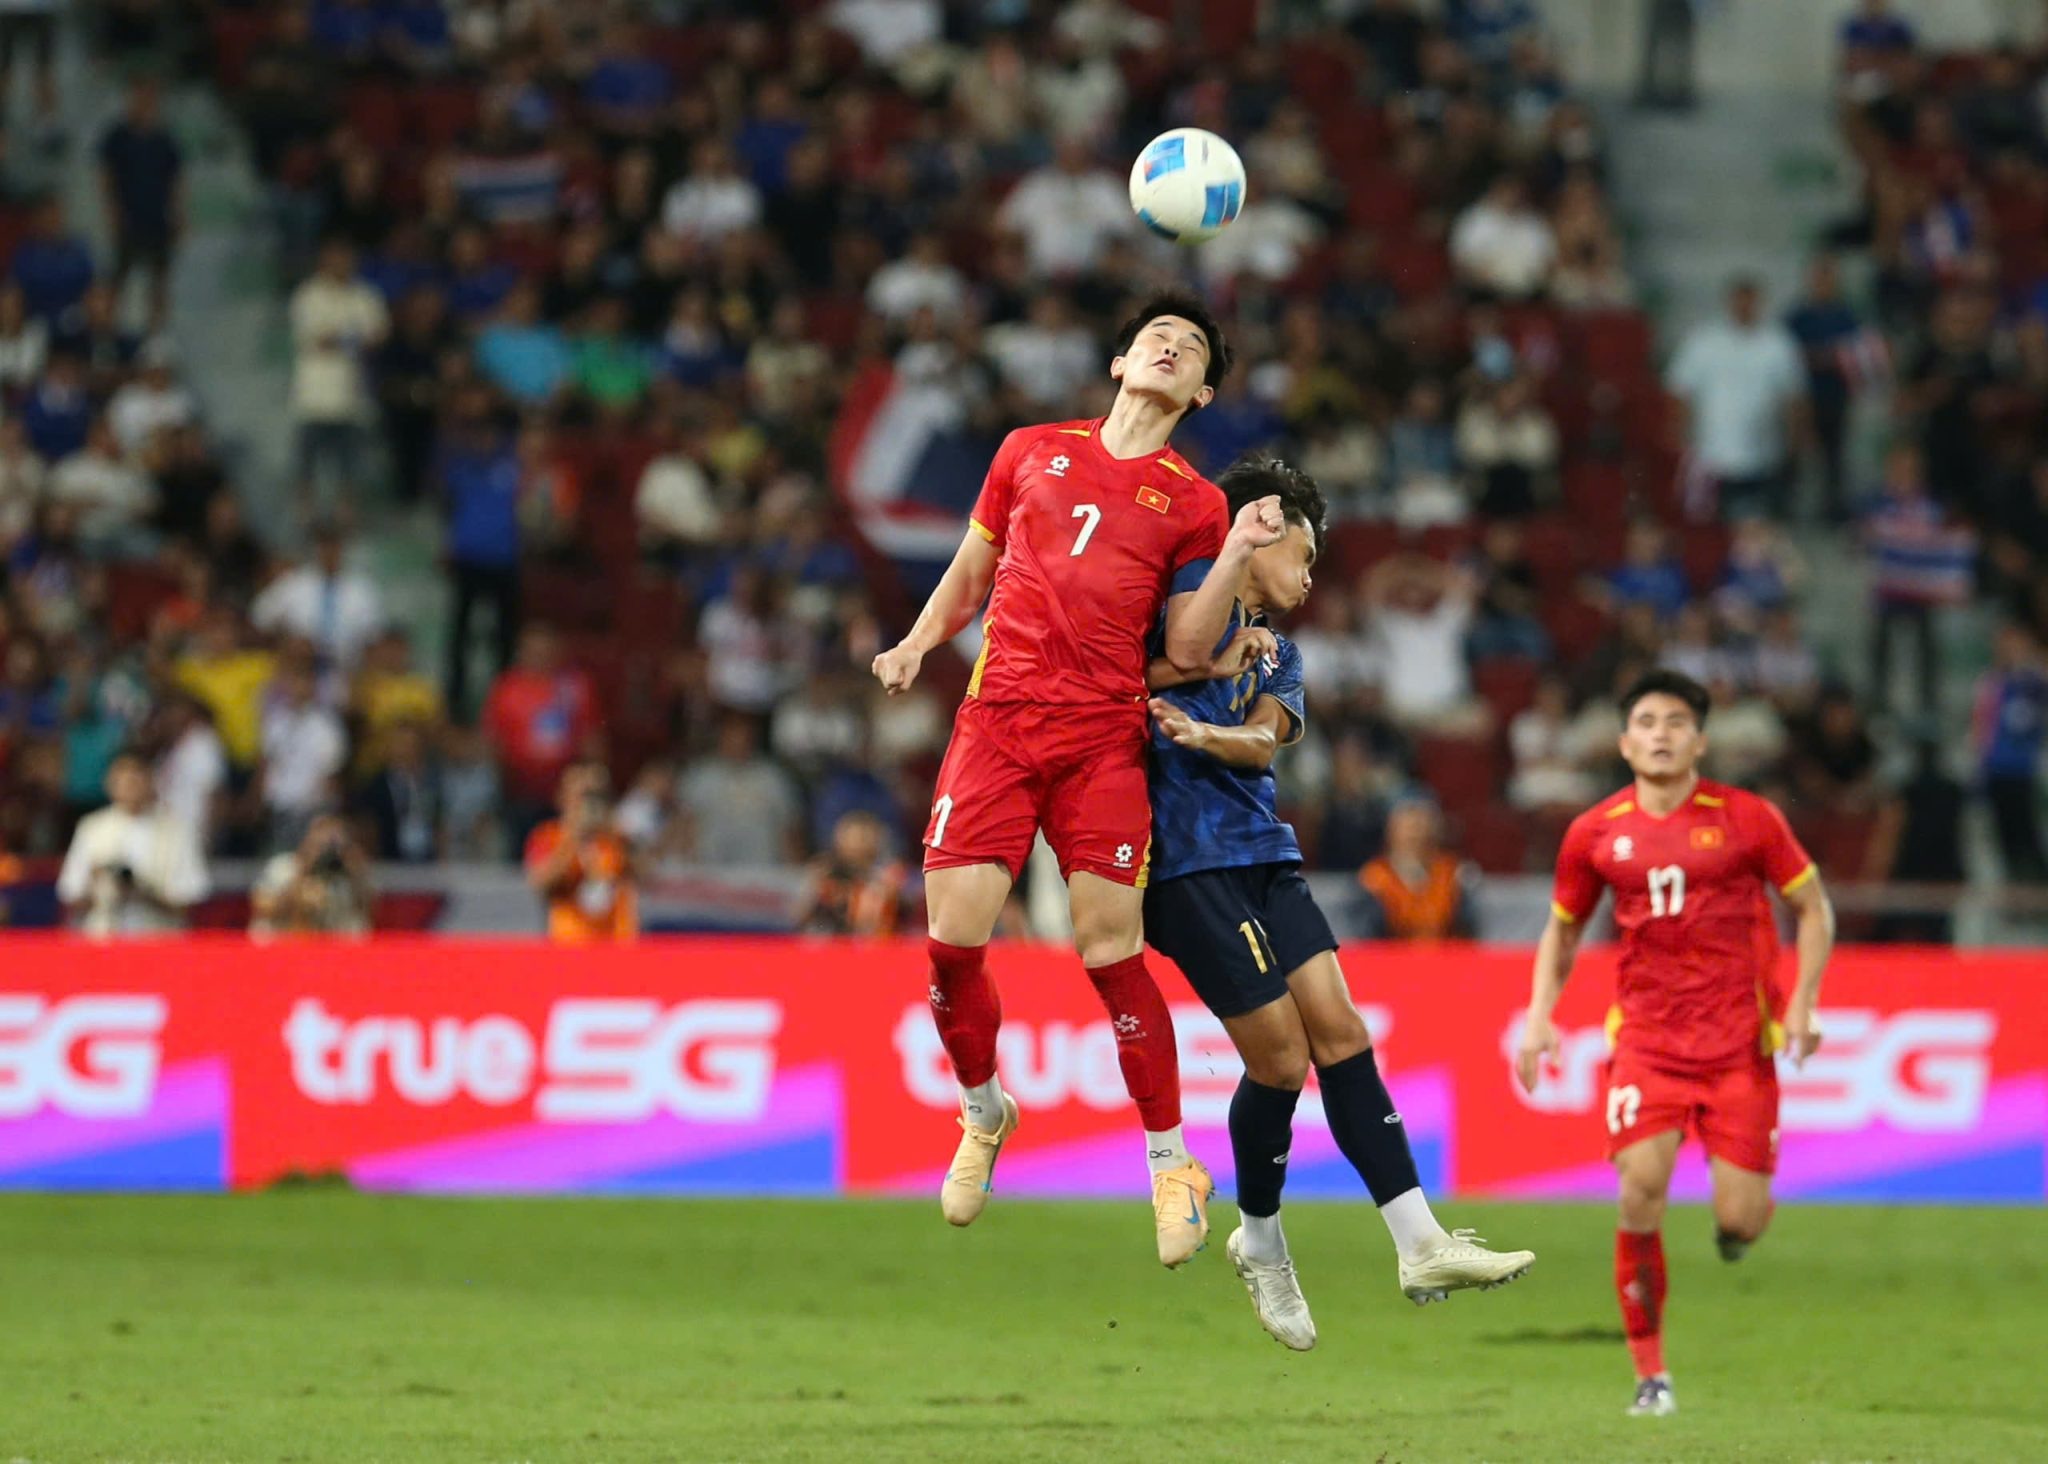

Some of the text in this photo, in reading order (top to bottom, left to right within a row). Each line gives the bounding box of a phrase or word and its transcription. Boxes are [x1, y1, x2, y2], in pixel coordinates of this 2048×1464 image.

[1070, 503, 1102, 557] 7
[1647, 863, 1686, 918] 17
[1606, 1084, 1642, 1136] 17
